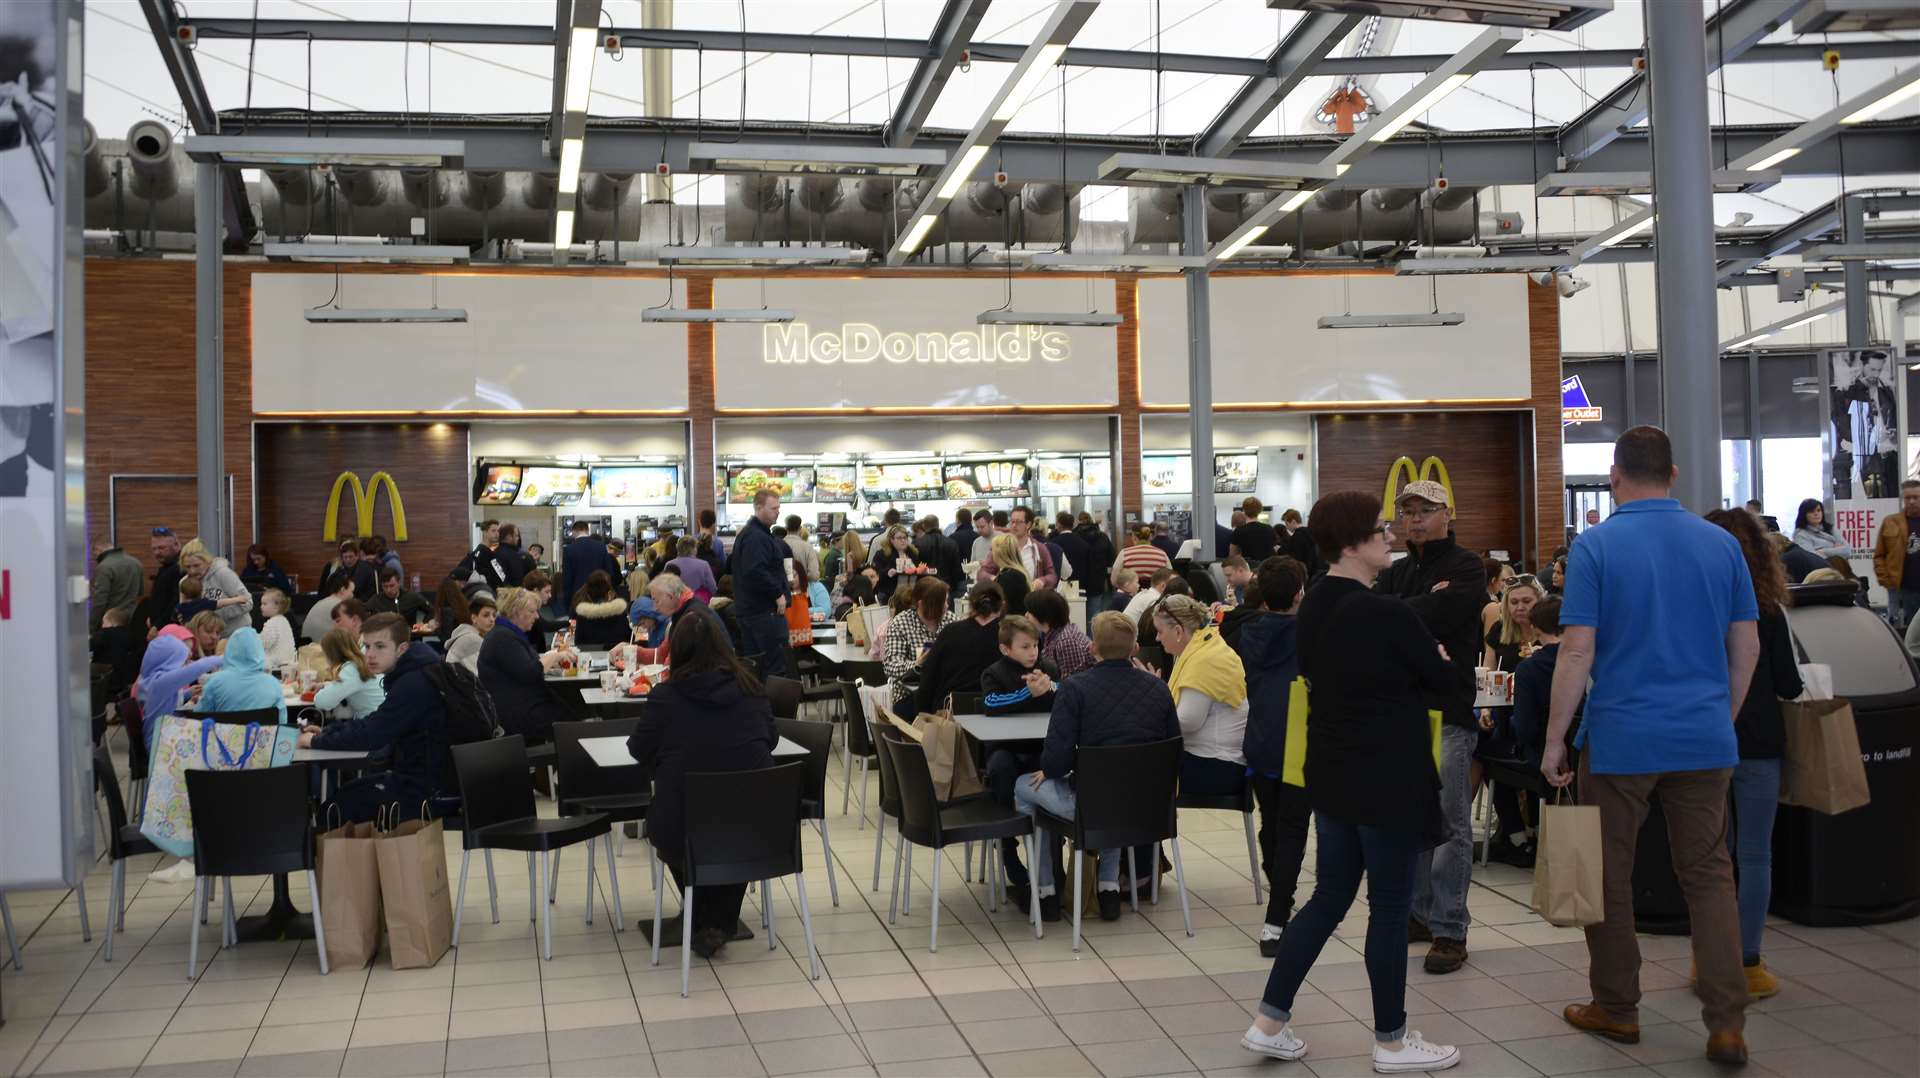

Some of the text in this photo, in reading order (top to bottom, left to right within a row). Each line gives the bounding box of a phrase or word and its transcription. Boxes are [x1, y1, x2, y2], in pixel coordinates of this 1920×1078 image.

[763, 323, 1070, 363] McDonald's
[1837, 510, 1875, 529] FREE
[1873, 751, 1883, 761] to
[1886, 746, 1911, 760] landfill
